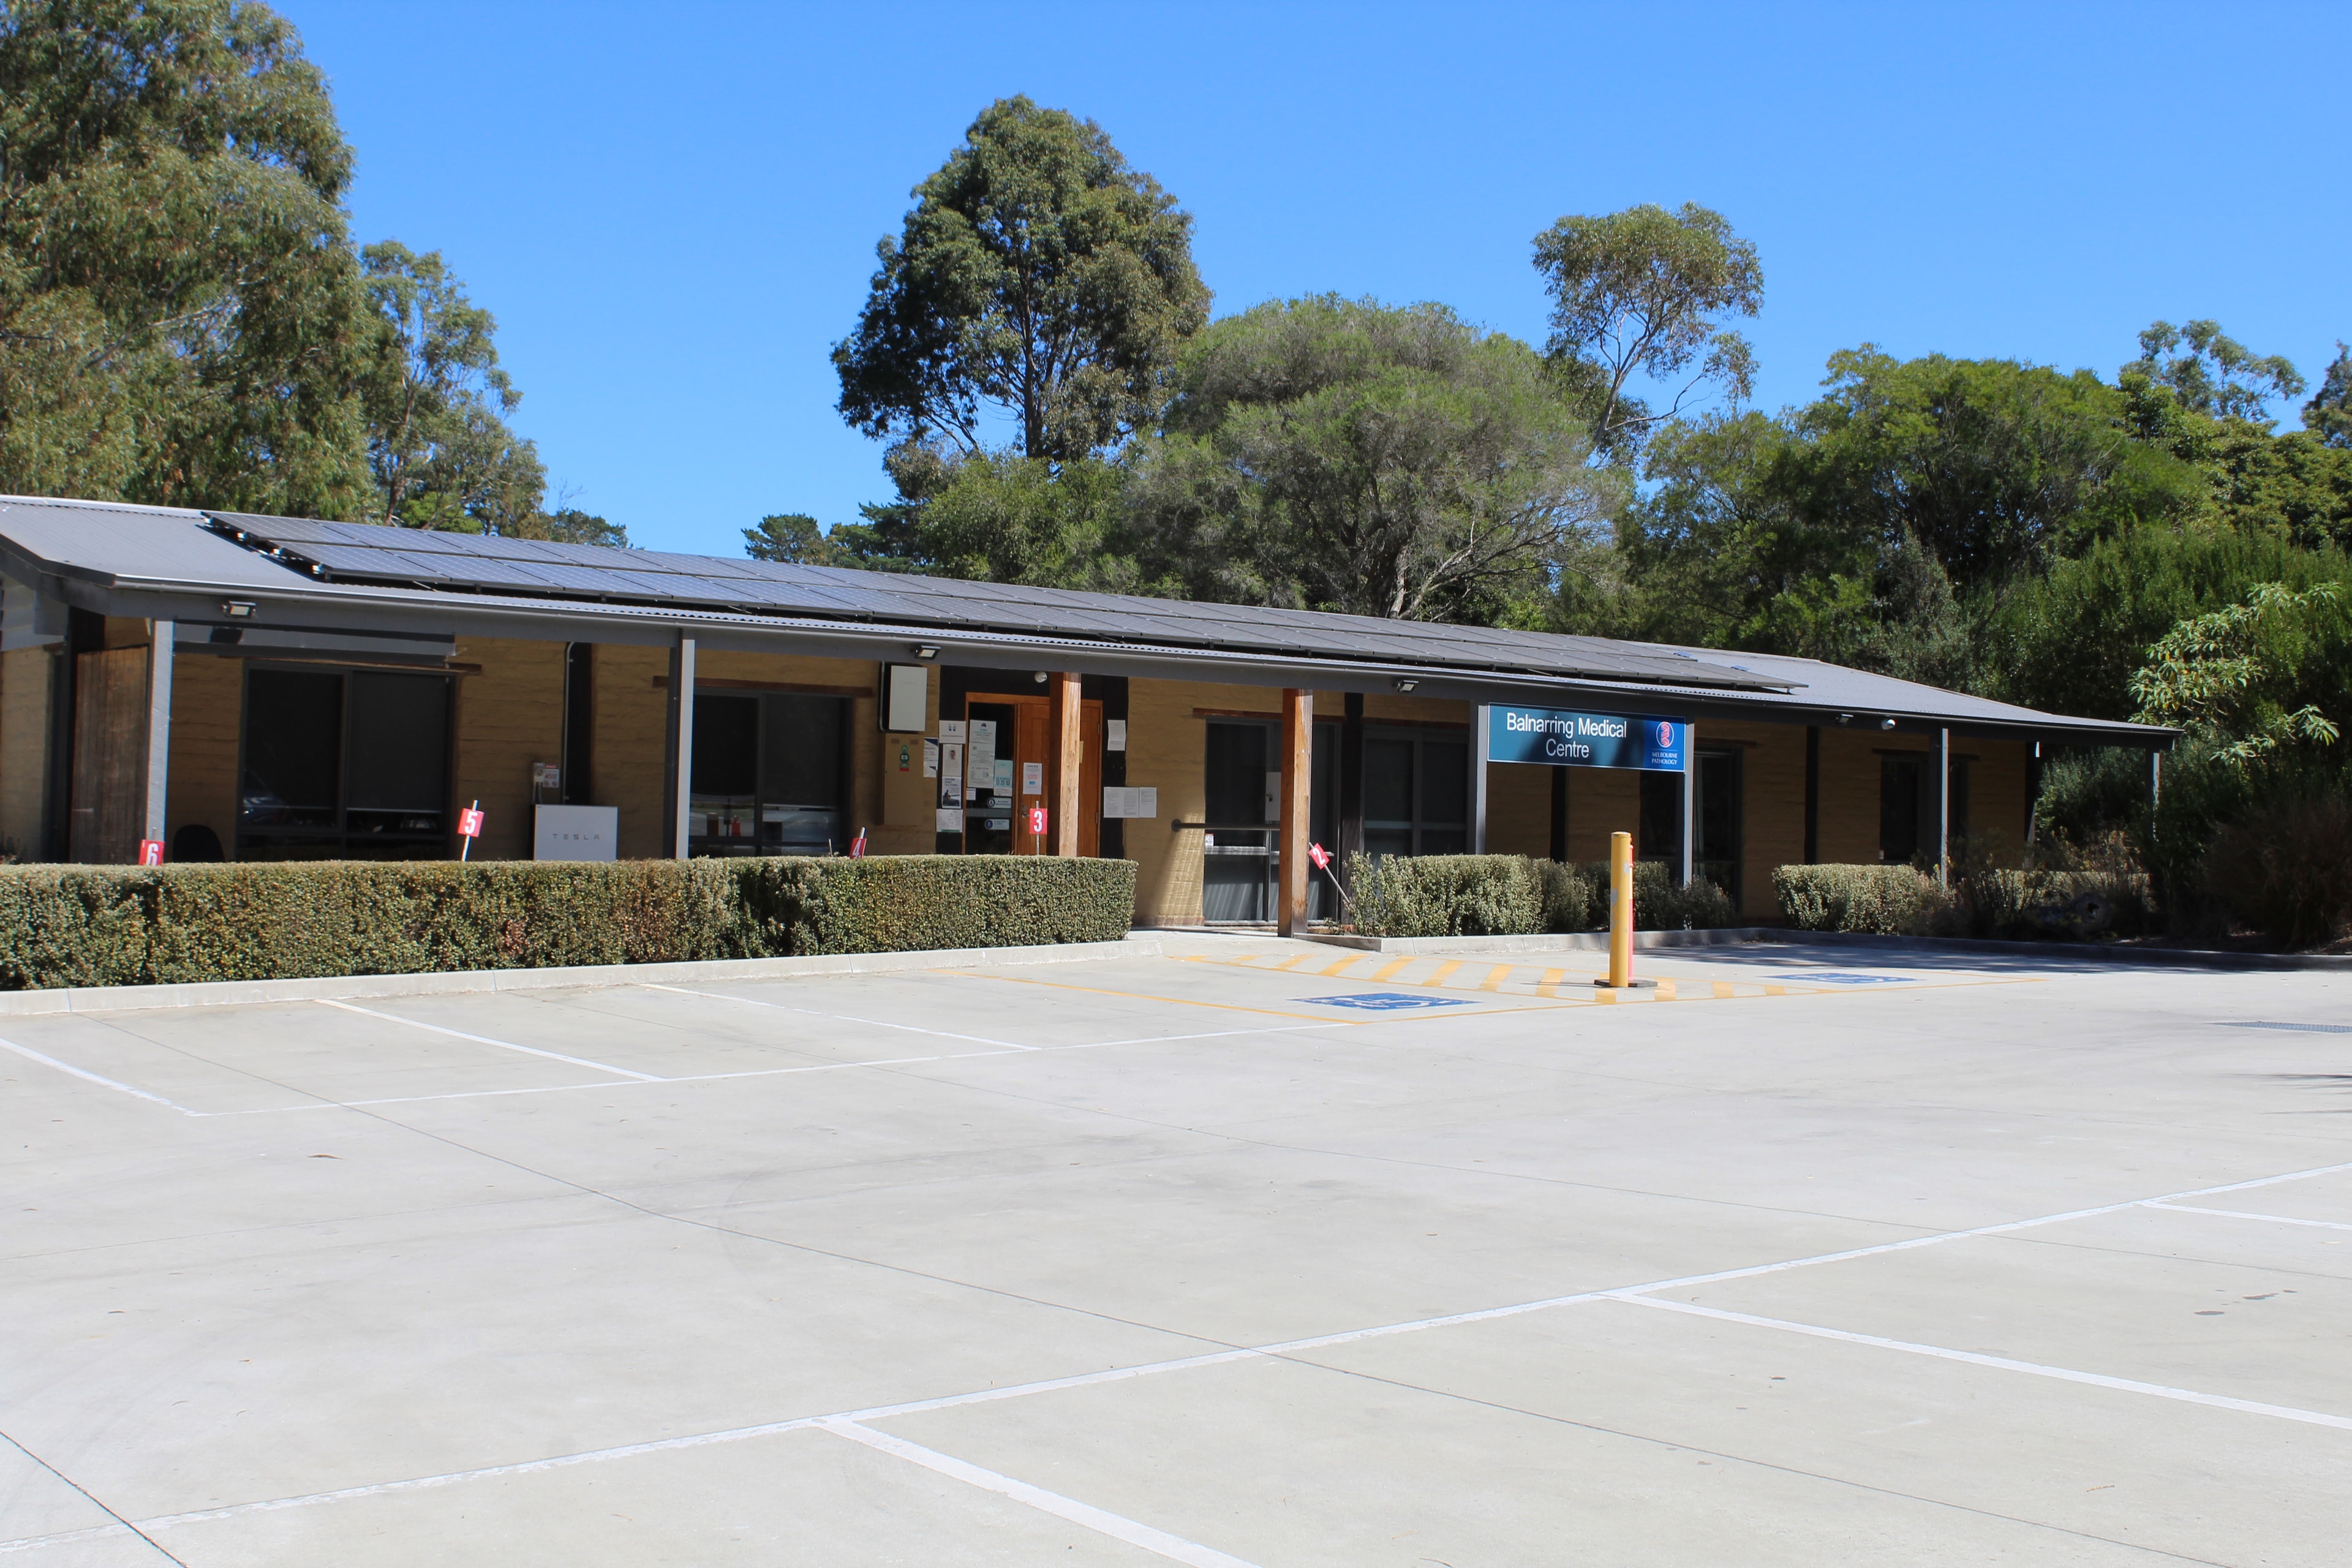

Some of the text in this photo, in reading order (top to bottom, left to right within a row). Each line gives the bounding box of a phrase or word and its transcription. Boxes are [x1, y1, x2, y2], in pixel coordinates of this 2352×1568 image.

[1506, 712, 1627, 739] Balnarring Medical
[1546, 738, 1589, 758] Centre
[464, 810, 478, 834] 5
[1033, 810, 1042, 832] 3
[146, 843, 159, 866] 6
[852, 839, 861, 858] 4
[1312, 847, 1326, 865] 2
